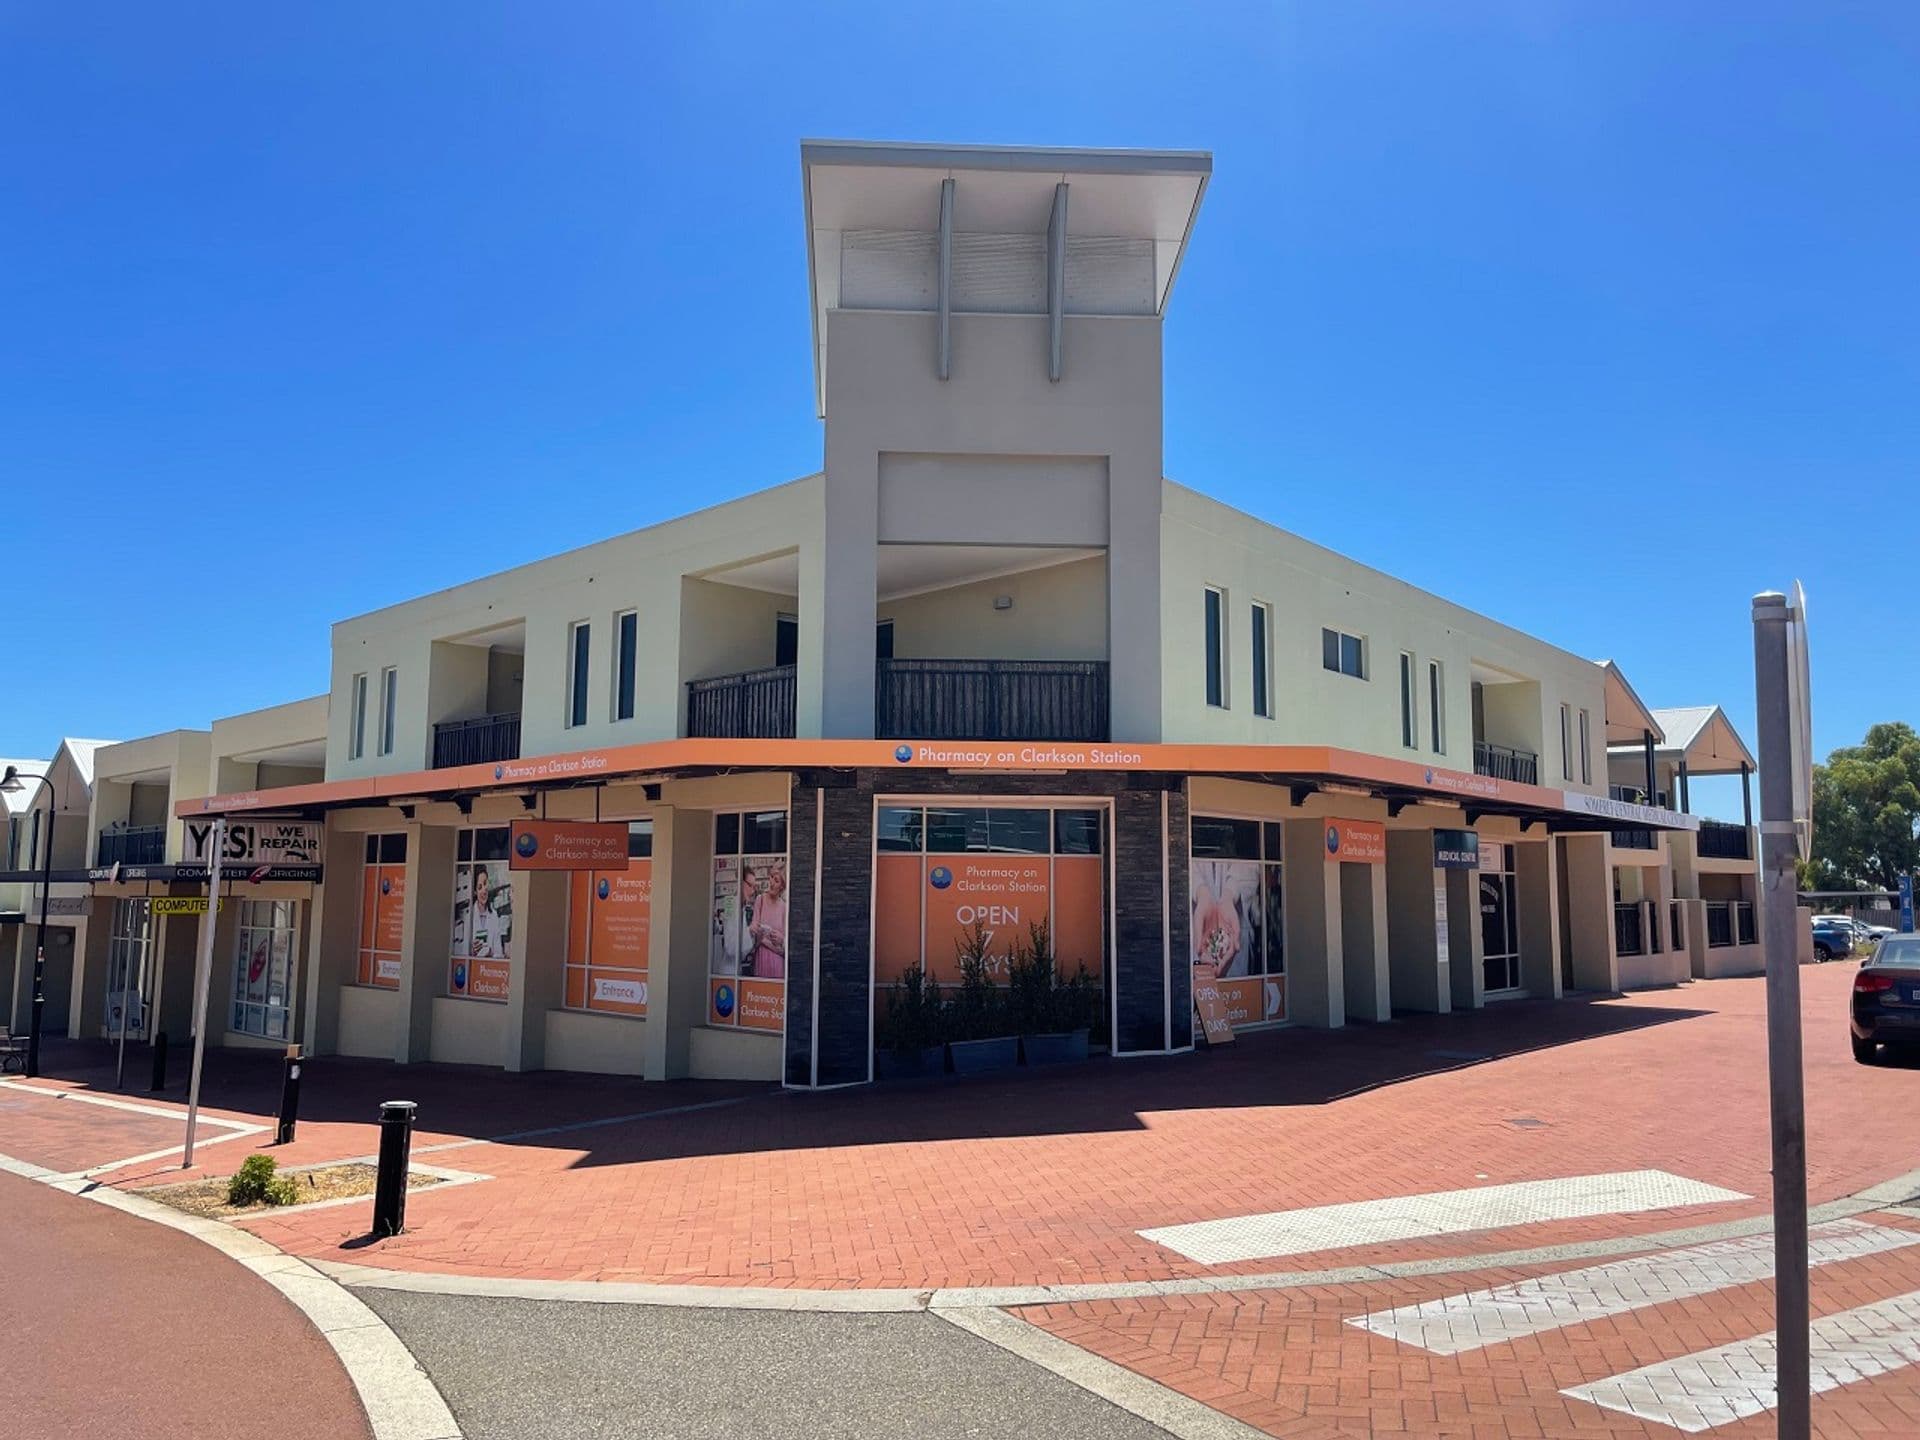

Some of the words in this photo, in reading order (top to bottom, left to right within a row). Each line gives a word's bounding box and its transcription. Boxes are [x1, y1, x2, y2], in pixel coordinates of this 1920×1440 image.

[919, 747, 991, 765] Pharmacy
[997, 751, 1016, 762] on
[1021, 748, 1085, 763] Clarkson
[1090, 749, 1141, 764] Station
[505, 765, 536, 777] Pharmacy
[538, 764, 547, 773] on
[548, 760, 578, 773] Clarkson
[582, 756, 607, 769] Station
[277, 826, 303, 837] WE
[261, 837, 317, 850] REPAIR
[554, 834, 600, 847] Pharmacy
[546, 847, 588, 859] Clarkson
[591, 849, 624, 860] Station
[967, 866, 1019, 879] Pharmacy
[1023, 869, 1037, 877] on
[957, 880, 1005, 891] Clarkson
[1008, 881, 1046, 892] Station
[156, 900, 221, 912] COMPUTES
[957, 905, 1018, 925] OPEN
[602, 982, 634, 999] Entrance
[746, 991, 779, 1008] Pharmacy
[741, 1004, 770, 1019] Clarkson
